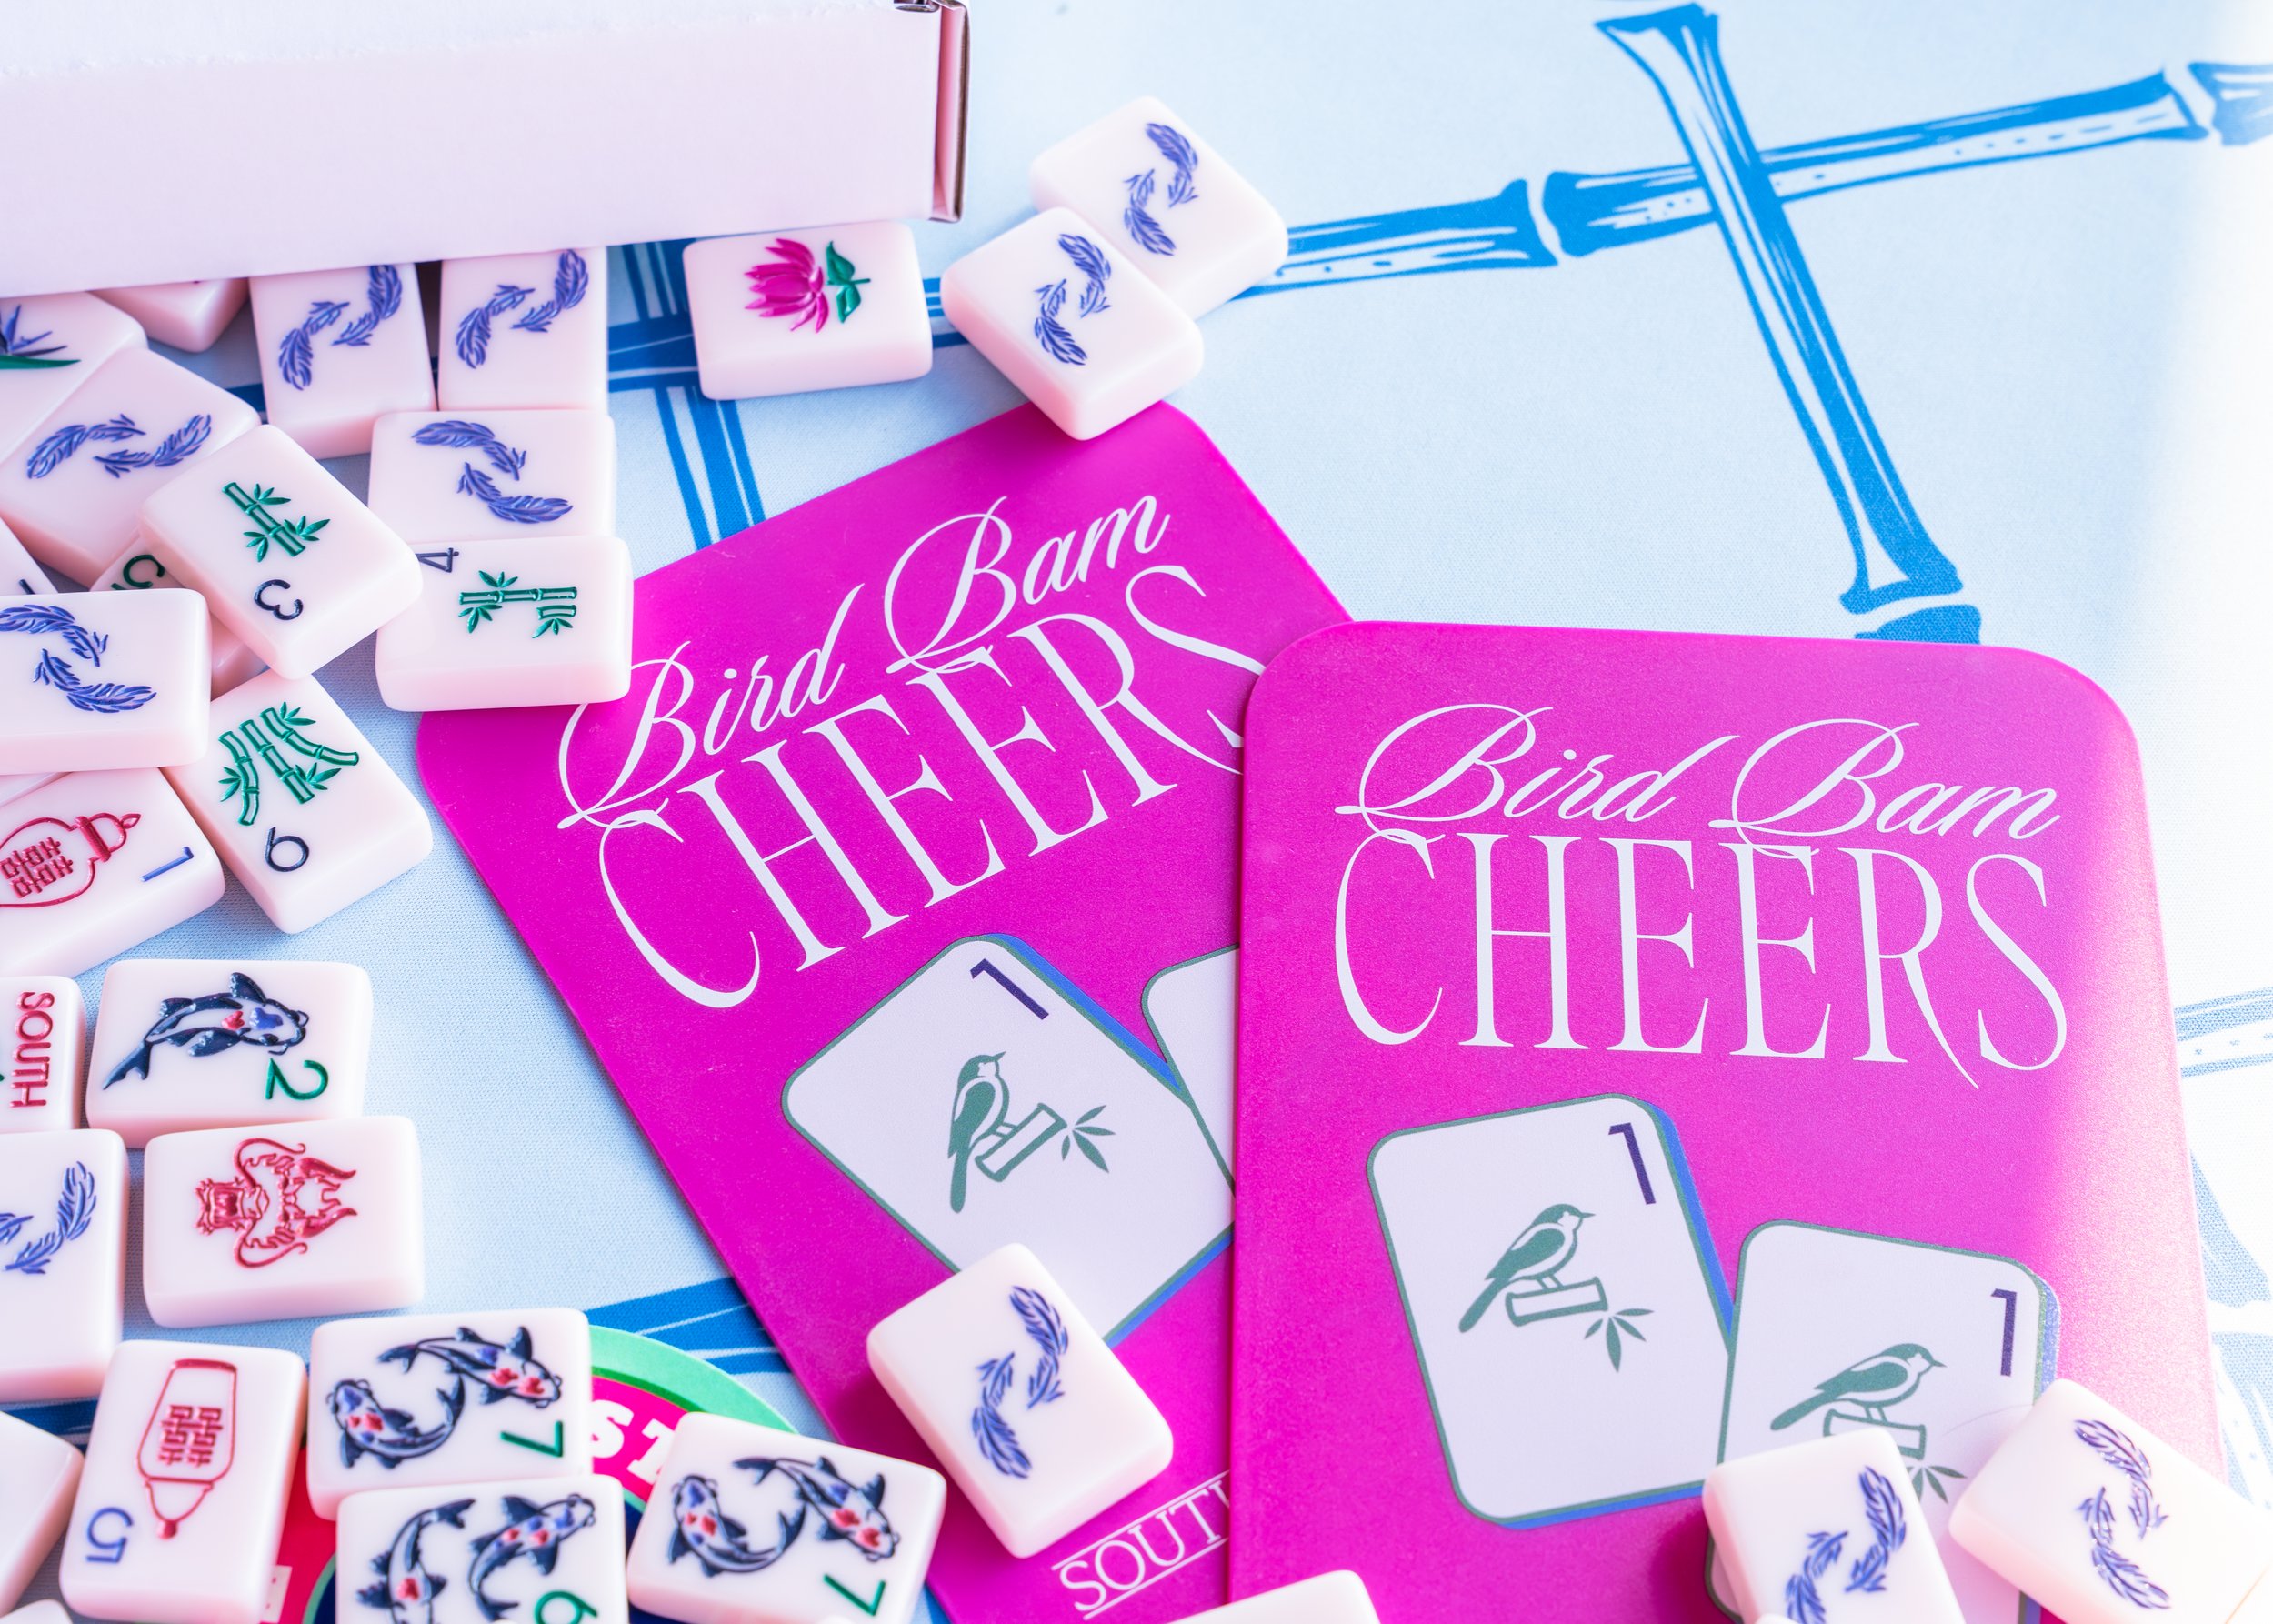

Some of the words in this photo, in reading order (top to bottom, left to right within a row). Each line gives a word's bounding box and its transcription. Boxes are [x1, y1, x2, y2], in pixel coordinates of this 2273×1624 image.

[415, 547, 459, 573] 4
[254, 579, 304, 620] 3
[557, 583, 866, 829] Bird
[885, 495, 1170, 673] Bam
[598, 565, 1265, 1008] CHEERS
[1335, 703, 1740, 844] Bird
[1708, 718, 2059, 859] Bam
[140, 847, 194, 883] 1
[970, 957, 1049, 1020] 1
[1334, 828, 2067, 1089] CHEERS
[10, 991, 55, 1108] SOUTH
[265, 1058, 329, 1100] 2
[1608, 1122, 1657, 1205] 1
[1990, 1288, 2018, 1377] 1
[499, 1420, 564, 1458] 7
[85, 1507, 134, 1563] 5
[1059, 1480, 1230, 1612] SOUT
[822, 1574, 886, 1617] 7
